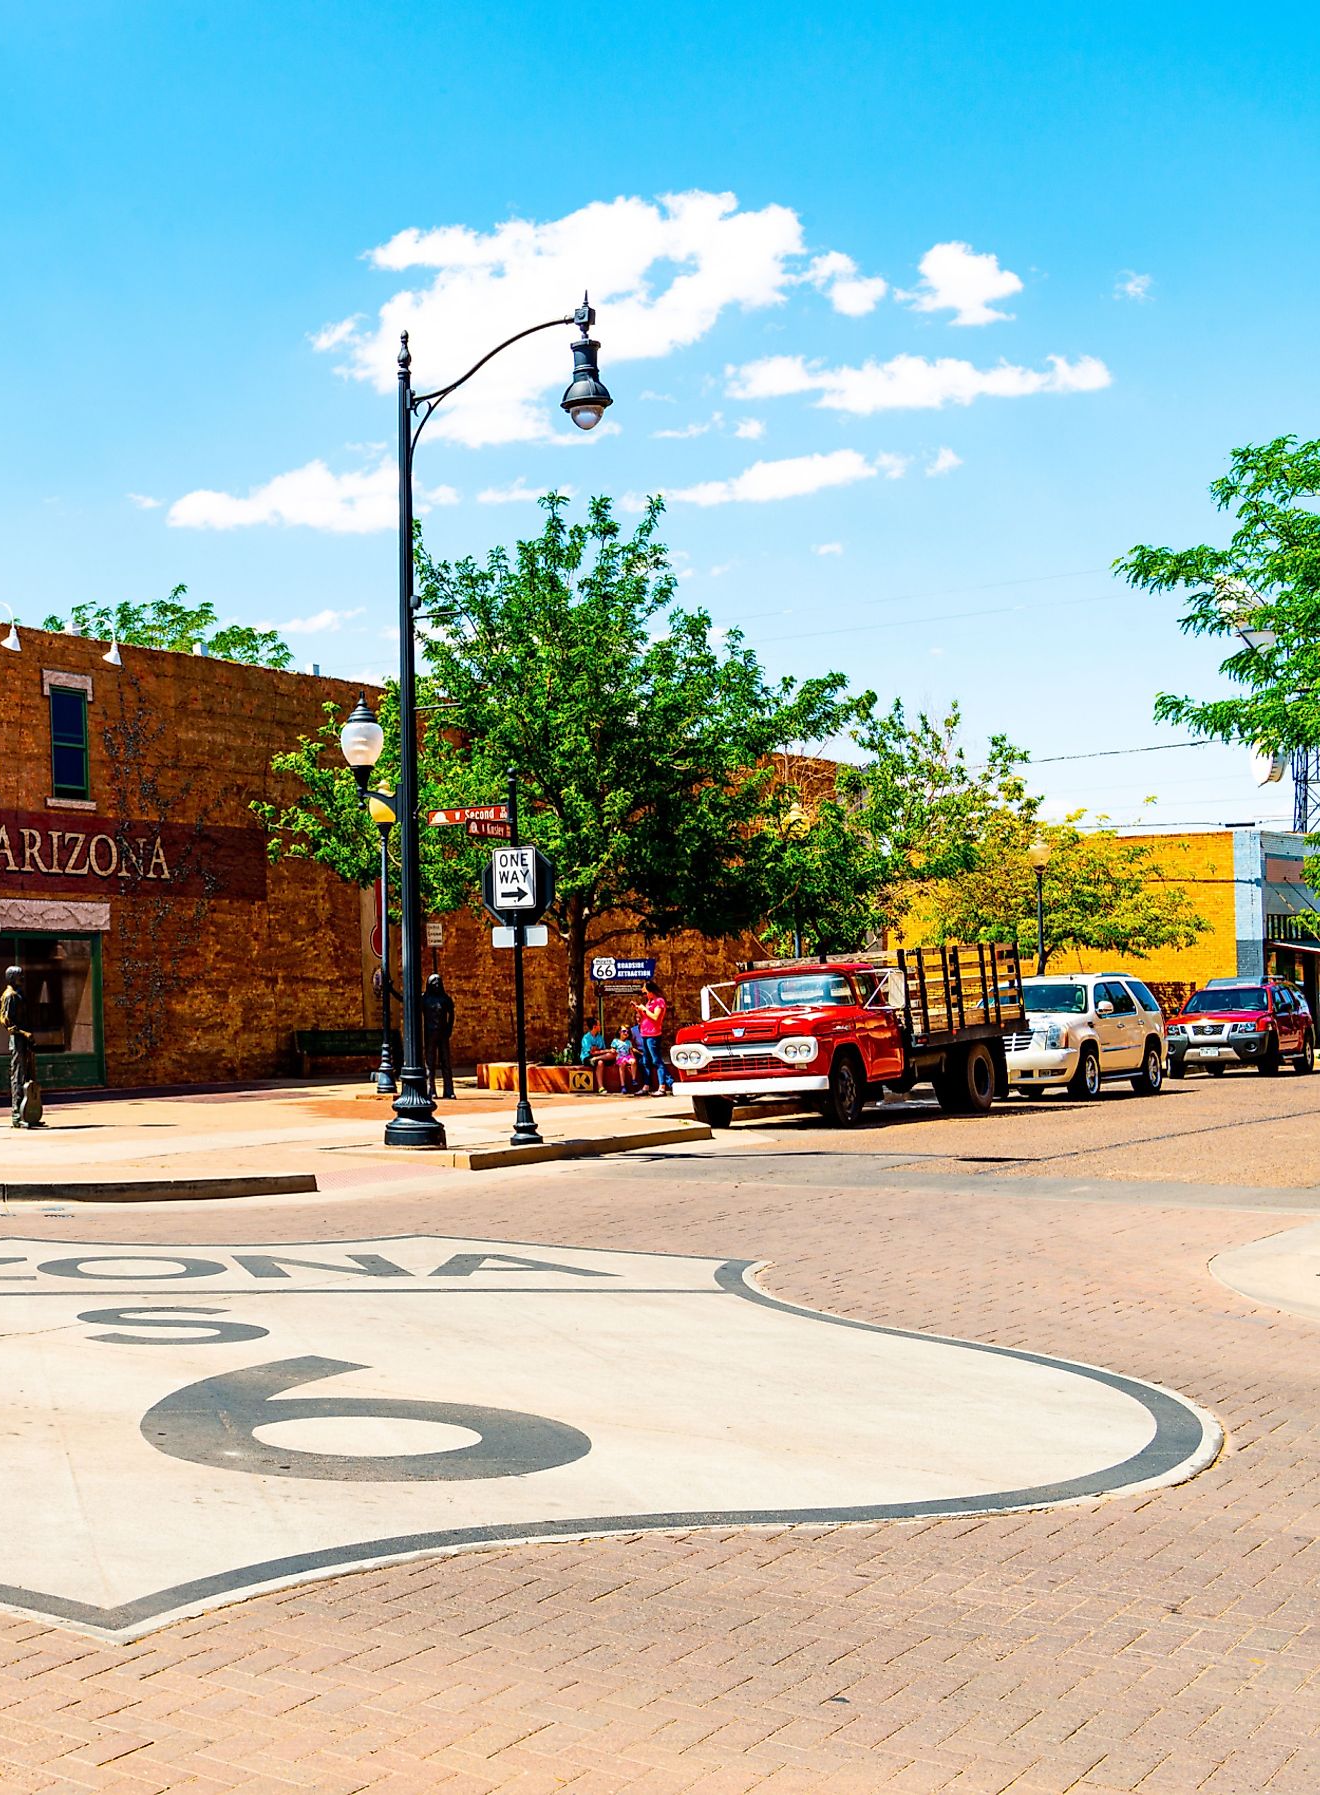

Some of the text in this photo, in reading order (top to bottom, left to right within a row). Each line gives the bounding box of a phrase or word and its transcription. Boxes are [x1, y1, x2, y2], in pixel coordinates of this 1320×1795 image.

[465, 808, 494, 819] Second
[500, 853, 529, 868] ONE
[499, 869, 530, 884] WAY
[597, 965, 613, 977] 66
